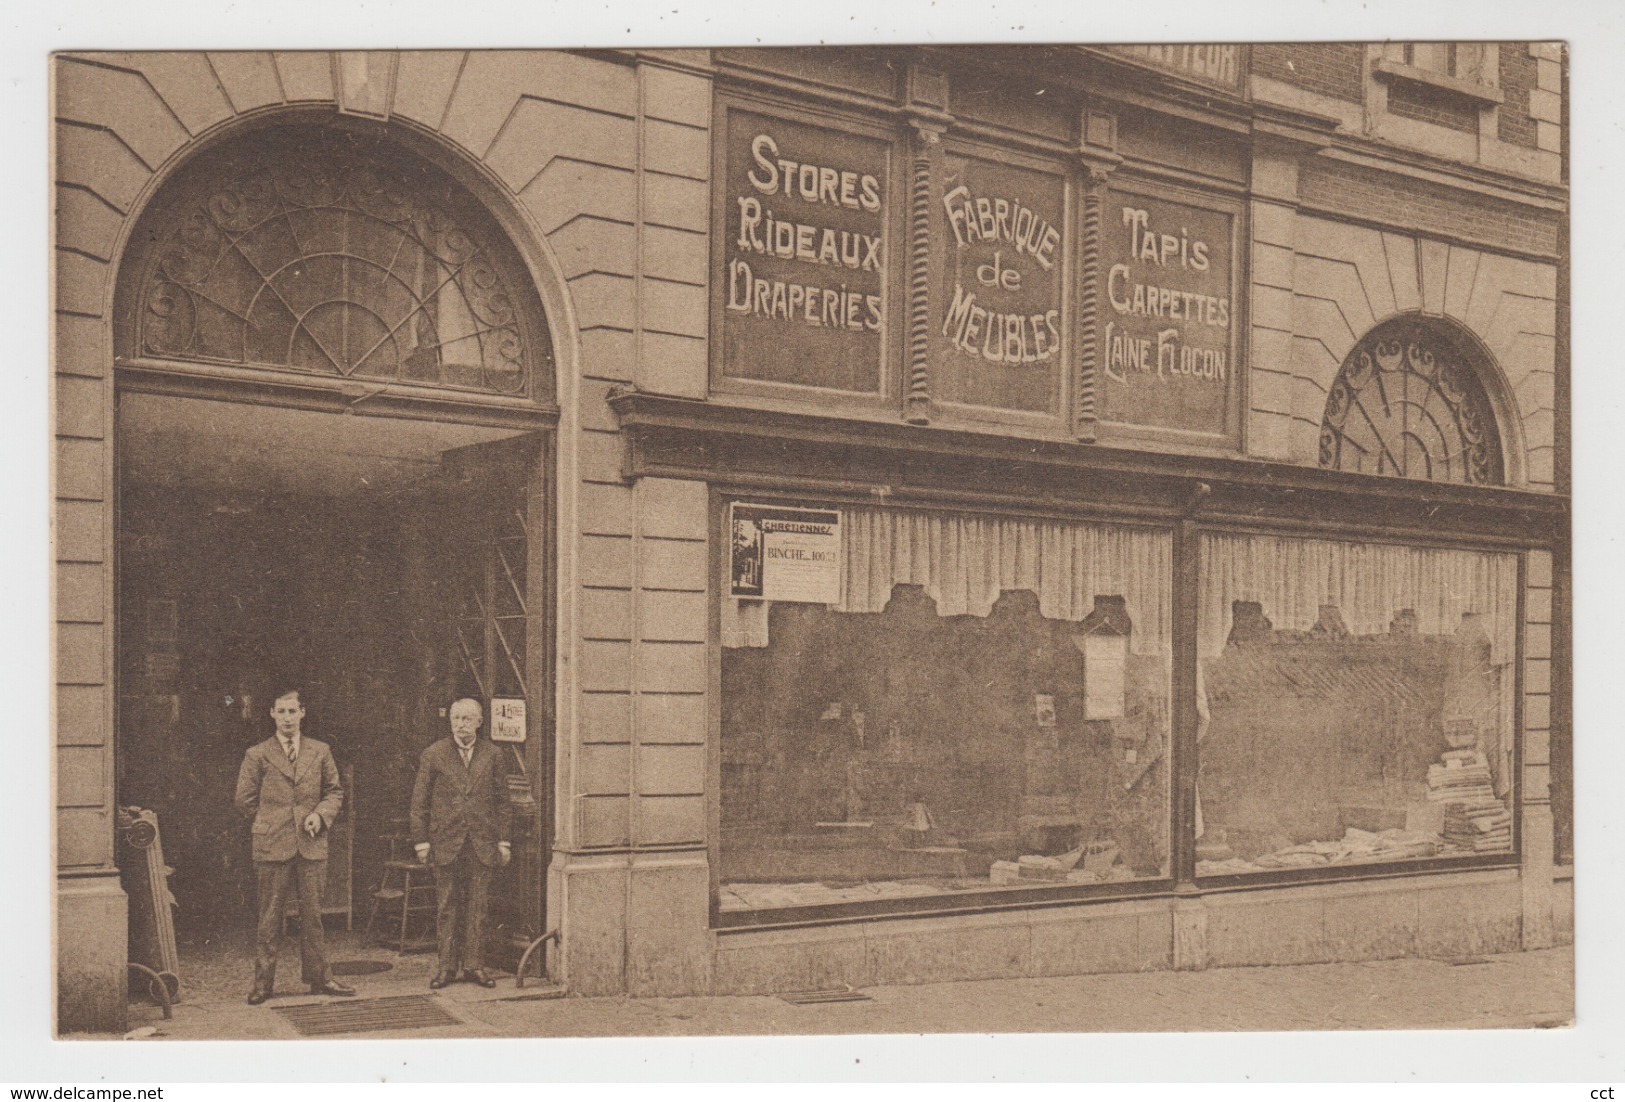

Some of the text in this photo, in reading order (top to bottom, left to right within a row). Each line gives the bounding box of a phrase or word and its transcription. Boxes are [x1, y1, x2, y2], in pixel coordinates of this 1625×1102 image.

[748, 134, 881, 212] STORES
[943, 185, 1061, 271] FABRIQUE
[976, 250, 1021, 291] de
[1108, 263, 1229, 328] CARPETTES
[942, 283, 1060, 364] MEUBLES
[1157, 328, 1226, 382] FLOCON
